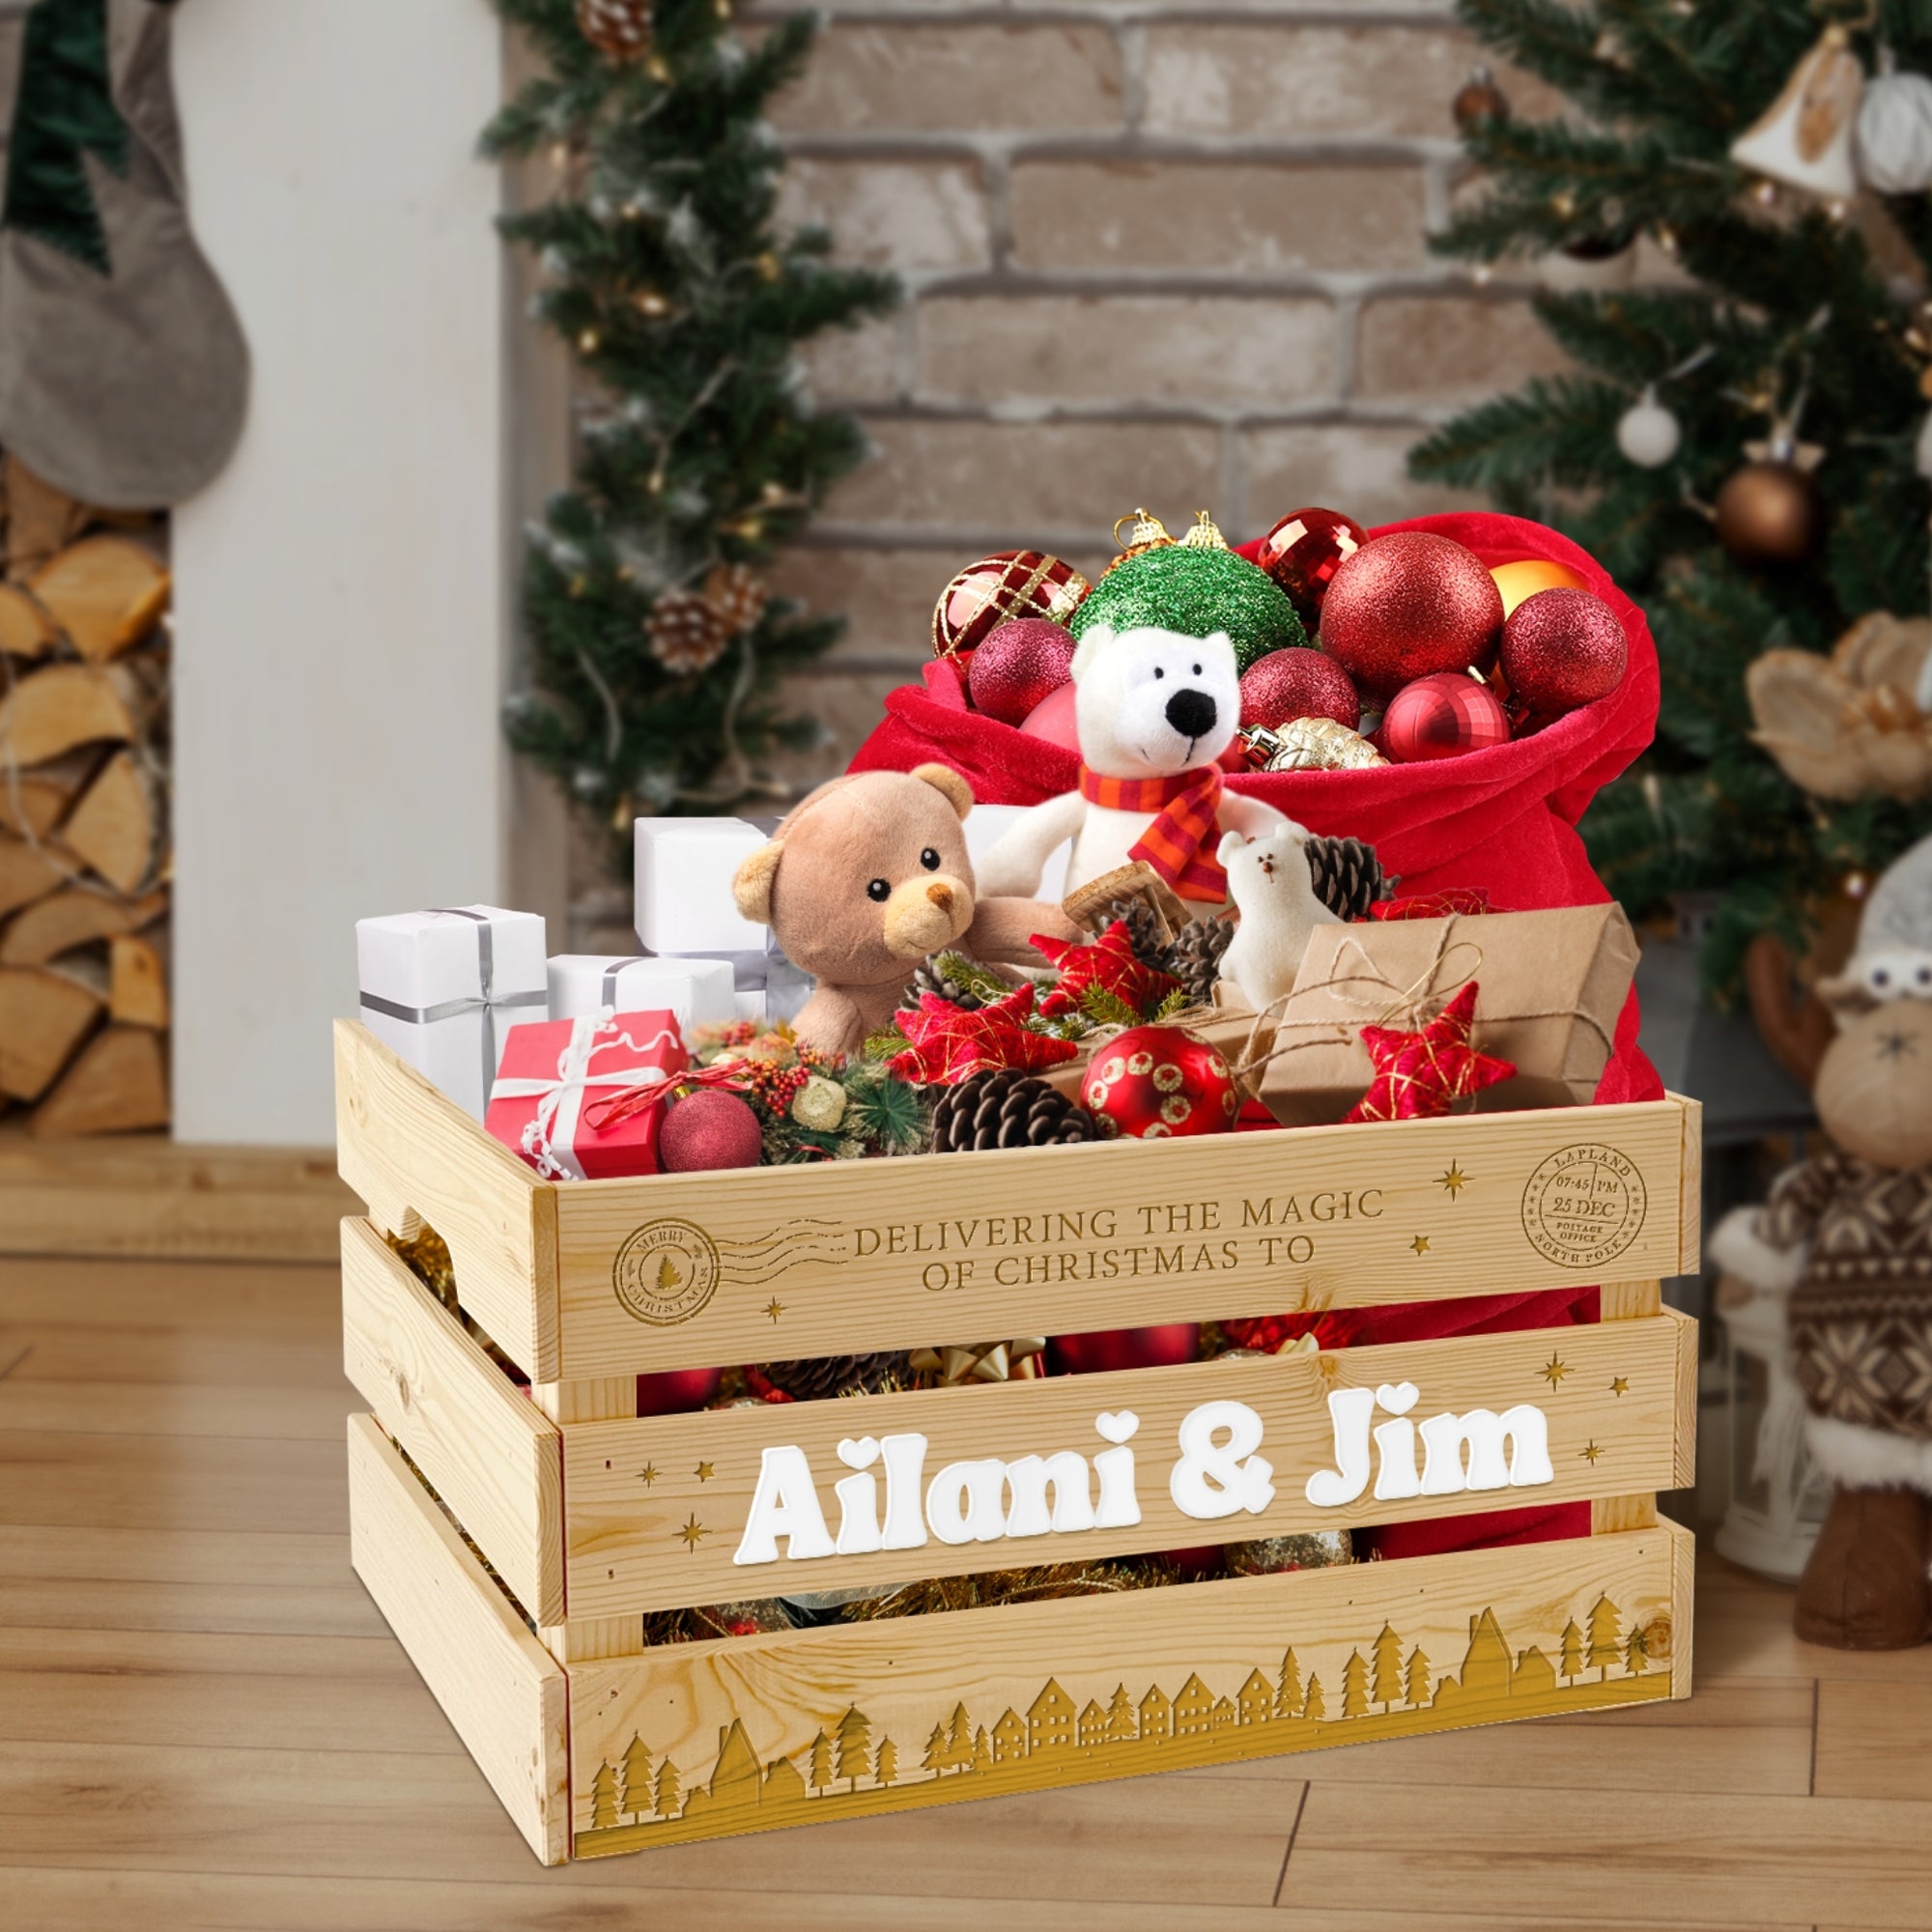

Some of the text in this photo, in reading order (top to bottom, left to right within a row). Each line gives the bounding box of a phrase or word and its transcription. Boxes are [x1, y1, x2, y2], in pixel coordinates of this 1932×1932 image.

[1553, 1149, 1631, 1177] LAPLAND
[1556, 1177, 1618, 1193] 07:45 PM
[1553, 1197, 1615, 1217] 25 DEC
[854, 1189, 1384, 1257] DELIVERING THE MAGIC
[1556, 1222, 1604, 1234] POSTAGE
[637, 1230, 687, 1252] MERRY
[1535, 1234, 1621, 1263] NORTH POLE
[1560, 1234, 1597, 1243] OFFICE
[923, 1236, 1316, 1293] OF CHRISTMAS TO
[627, 1267, 708, 1314] CHRISTMAS
[732, 1380, 1554, 1568] Ailani & Jim
